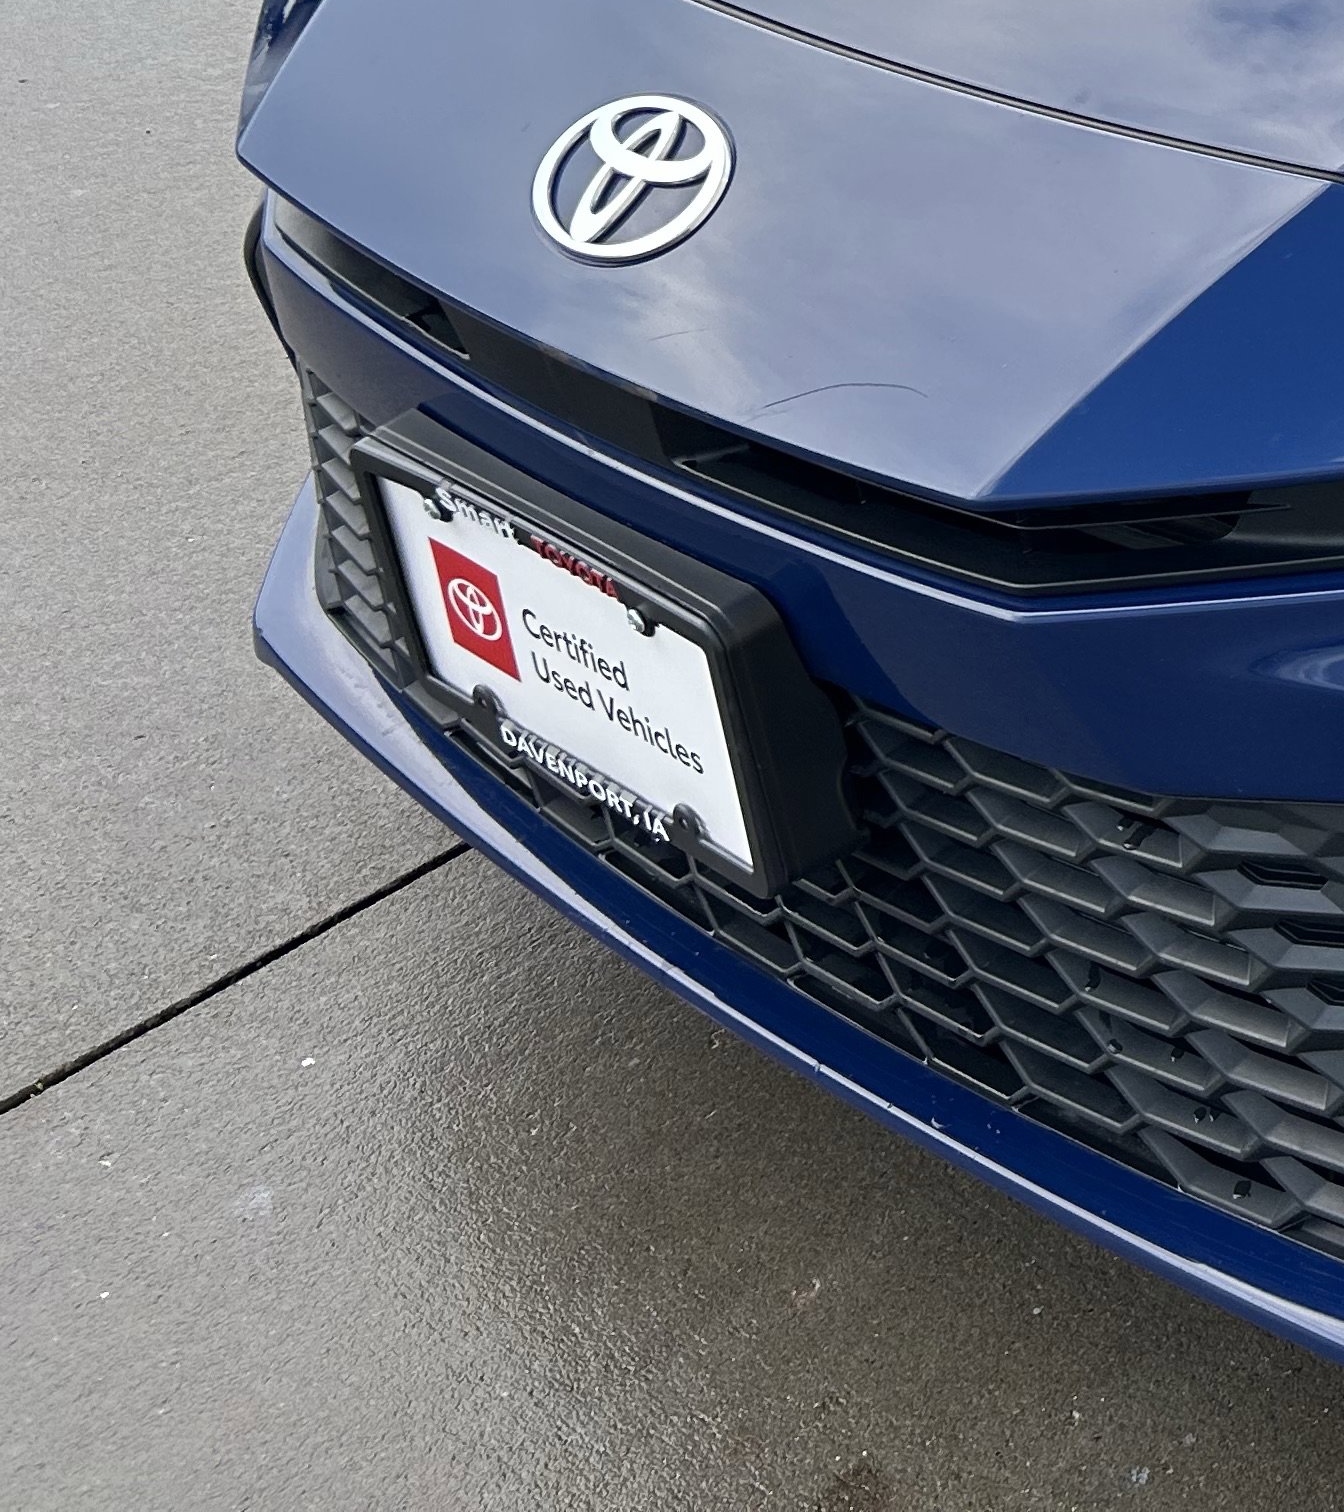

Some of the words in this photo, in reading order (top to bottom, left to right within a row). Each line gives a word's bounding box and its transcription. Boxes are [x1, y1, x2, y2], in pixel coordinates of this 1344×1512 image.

[436, 487, 516, 543] Smart
[530, 535, 619, 600] TOYOTA
[522, 608, 631, 691] Certified
[531, 652, 595, 712] Used
[598, 689, 705, 776] Vehicles
[501, 724, 641, 825] DAVENPORT,
[644, 804, 671, 841] IA
